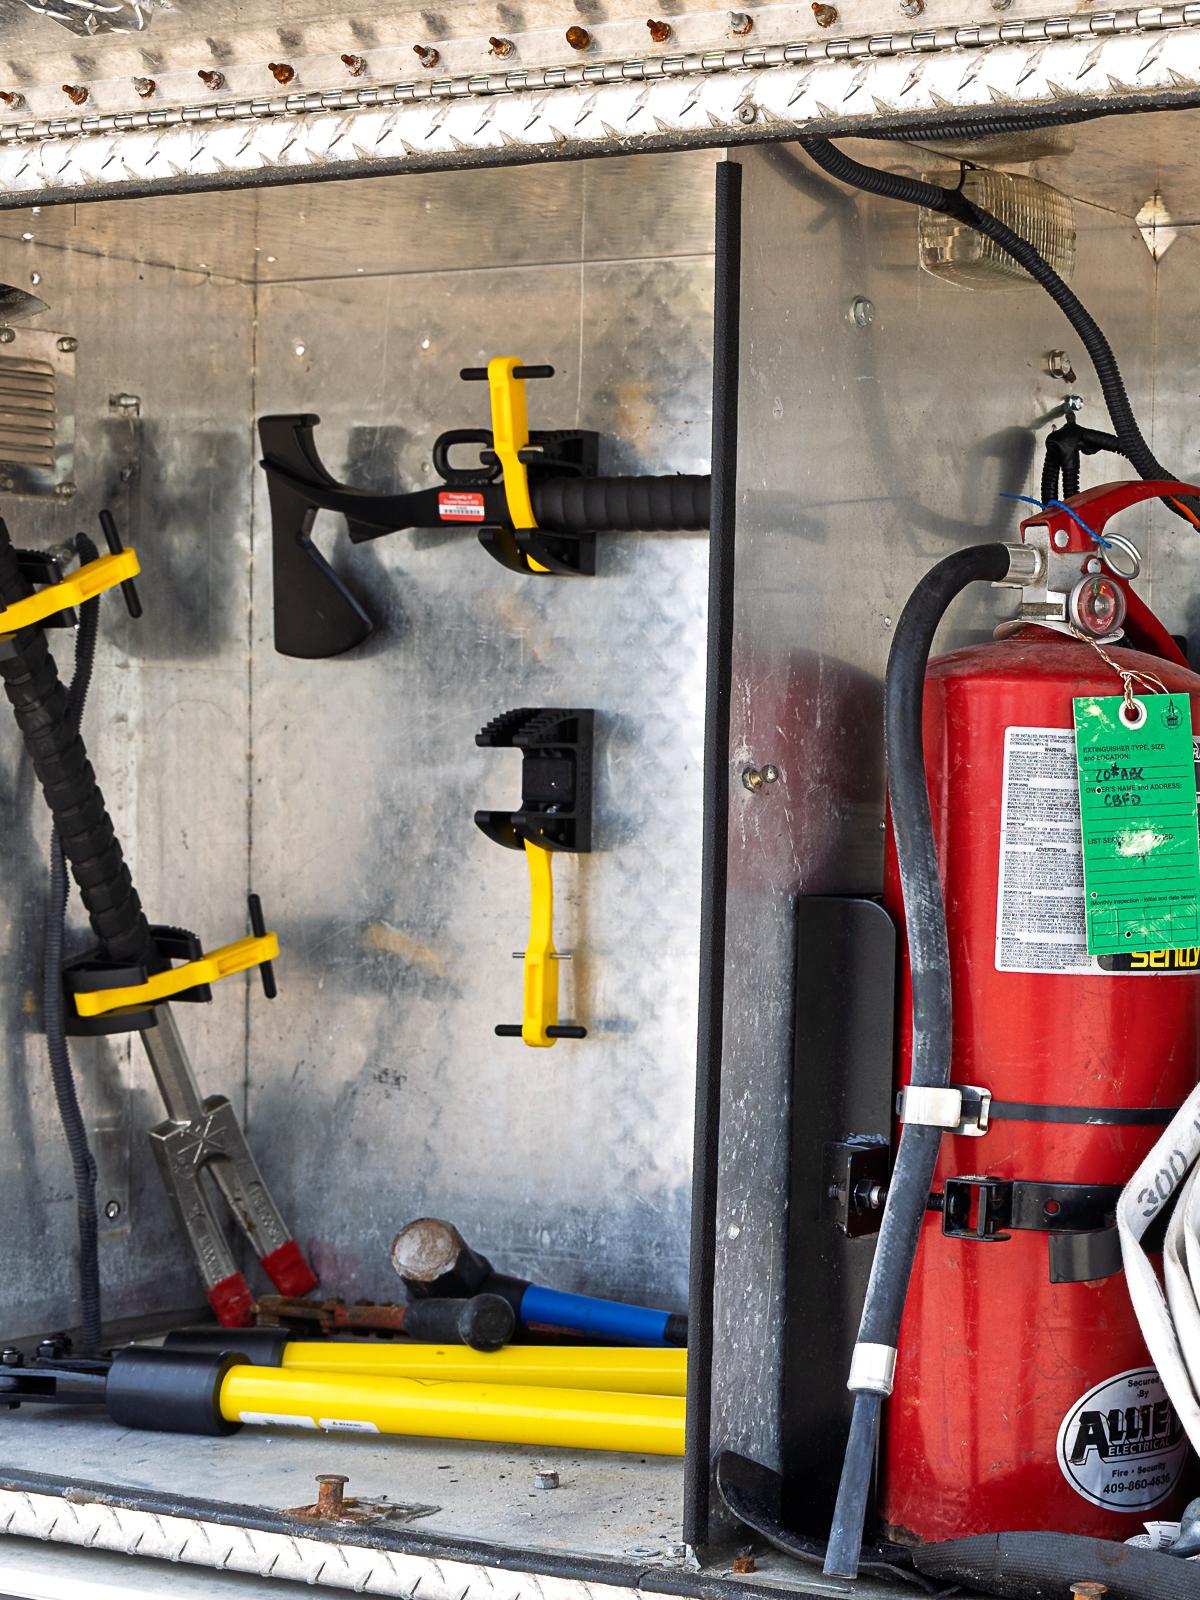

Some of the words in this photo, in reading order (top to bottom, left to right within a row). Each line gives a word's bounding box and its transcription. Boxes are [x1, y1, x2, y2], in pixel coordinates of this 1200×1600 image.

[1083, 744, 1130, 753] EXTINGUISHER
[1085, 786, 1116, 794] OWER'S
[1104, 793, 1142, 807] CBFD
[1136, 1149, 1189, 1217] 300
[1127, 1376, 1160, 1388] Secured
[1138, 1389, 1150, 1399] By
[1107, 1439, 1171, 1457] ELECTRICAL
[1112, 1469, 1129, 1478] Fire
[1137, 1463, 1167, 1475] Security
